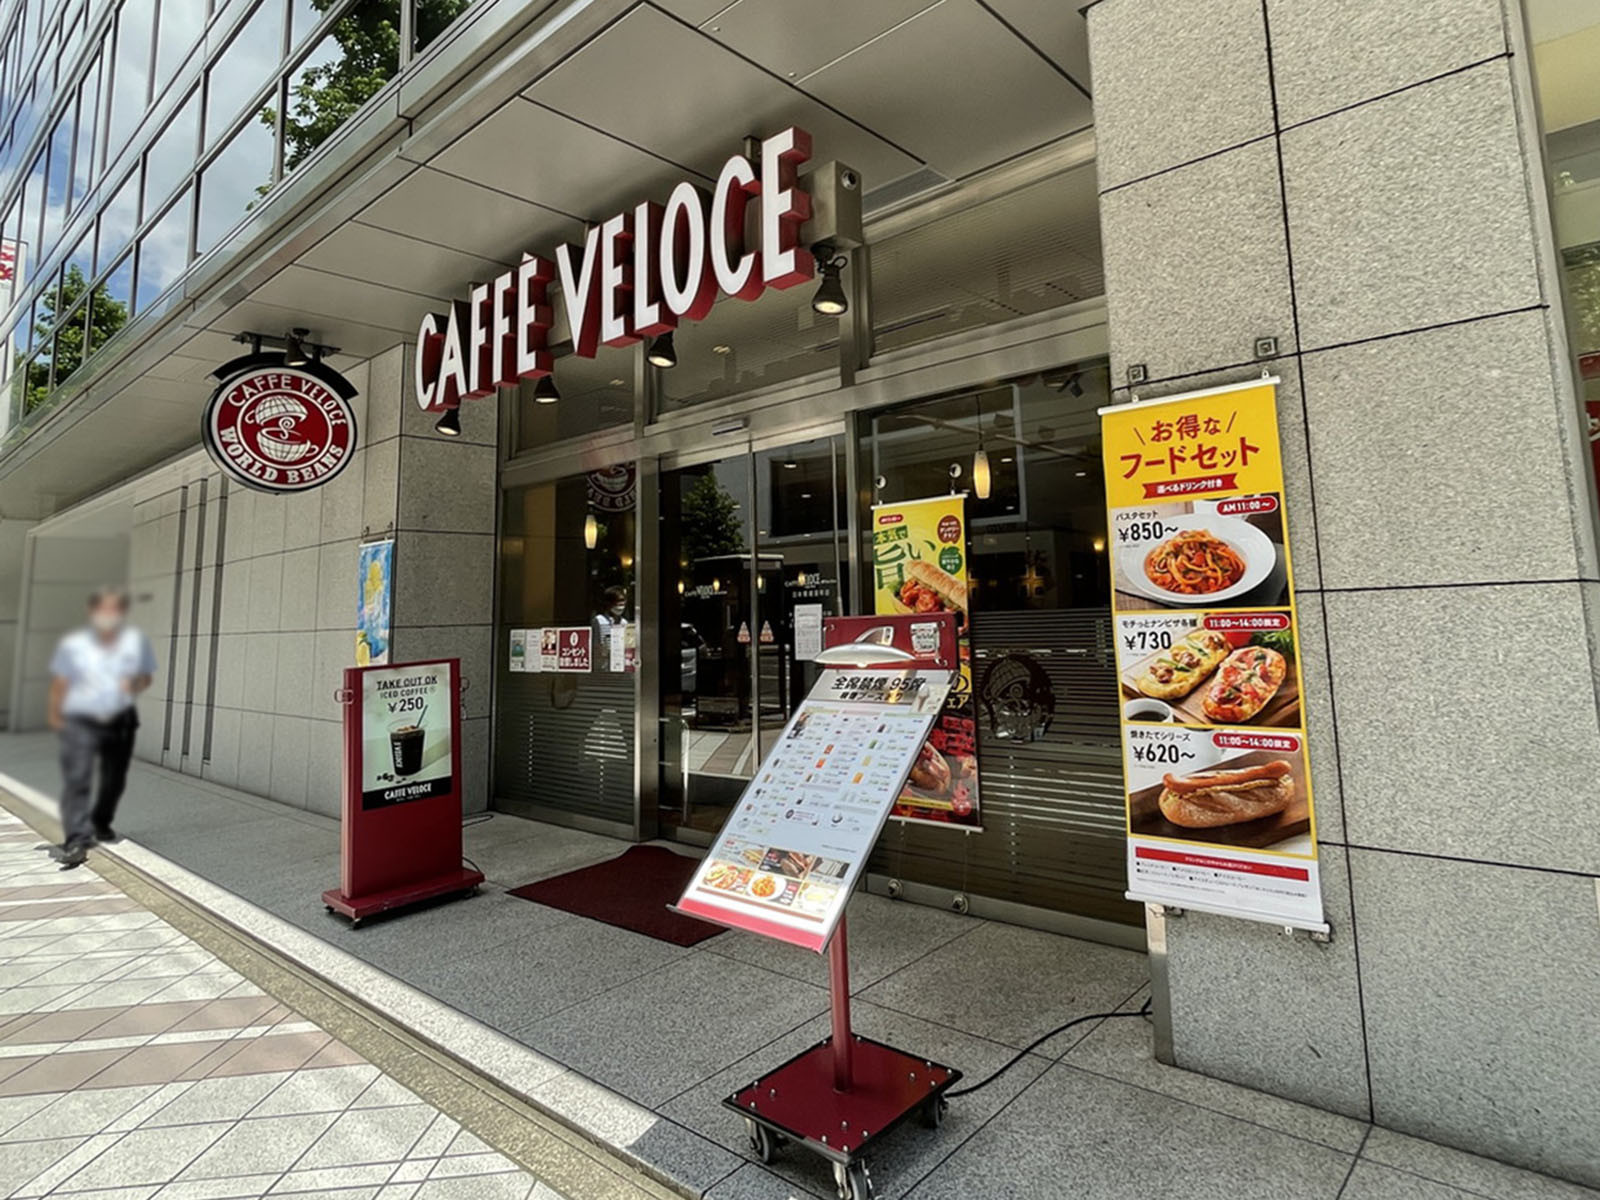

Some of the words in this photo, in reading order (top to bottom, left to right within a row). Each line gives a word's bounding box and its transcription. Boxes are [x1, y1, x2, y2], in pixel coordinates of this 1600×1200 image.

[555, 126, 808, 358] VELOCE
[228, 374, 292, 407] CAFFE
[301, 379, 347, 426] VELOCE
[1150, 413, 1221, 442] お得な
[219, 425, 279, 483] WORLD
[286, 444, 345, 484] BEANS
[1119, 436, 1260, 480] フードセット
[1115, 510, 1159, 521] パスタセット
[1124, 631, 1172, 650] ¥730
[376, 679, 401, 691] TAKE
[403, 676, 422, 687] OUT
[424, 674, 438, 685] OK
[379, 690, 399, 699] ICED
[400, 686, 428, 697] COFFEE
[407, 783, 432, 795] VELOCE
